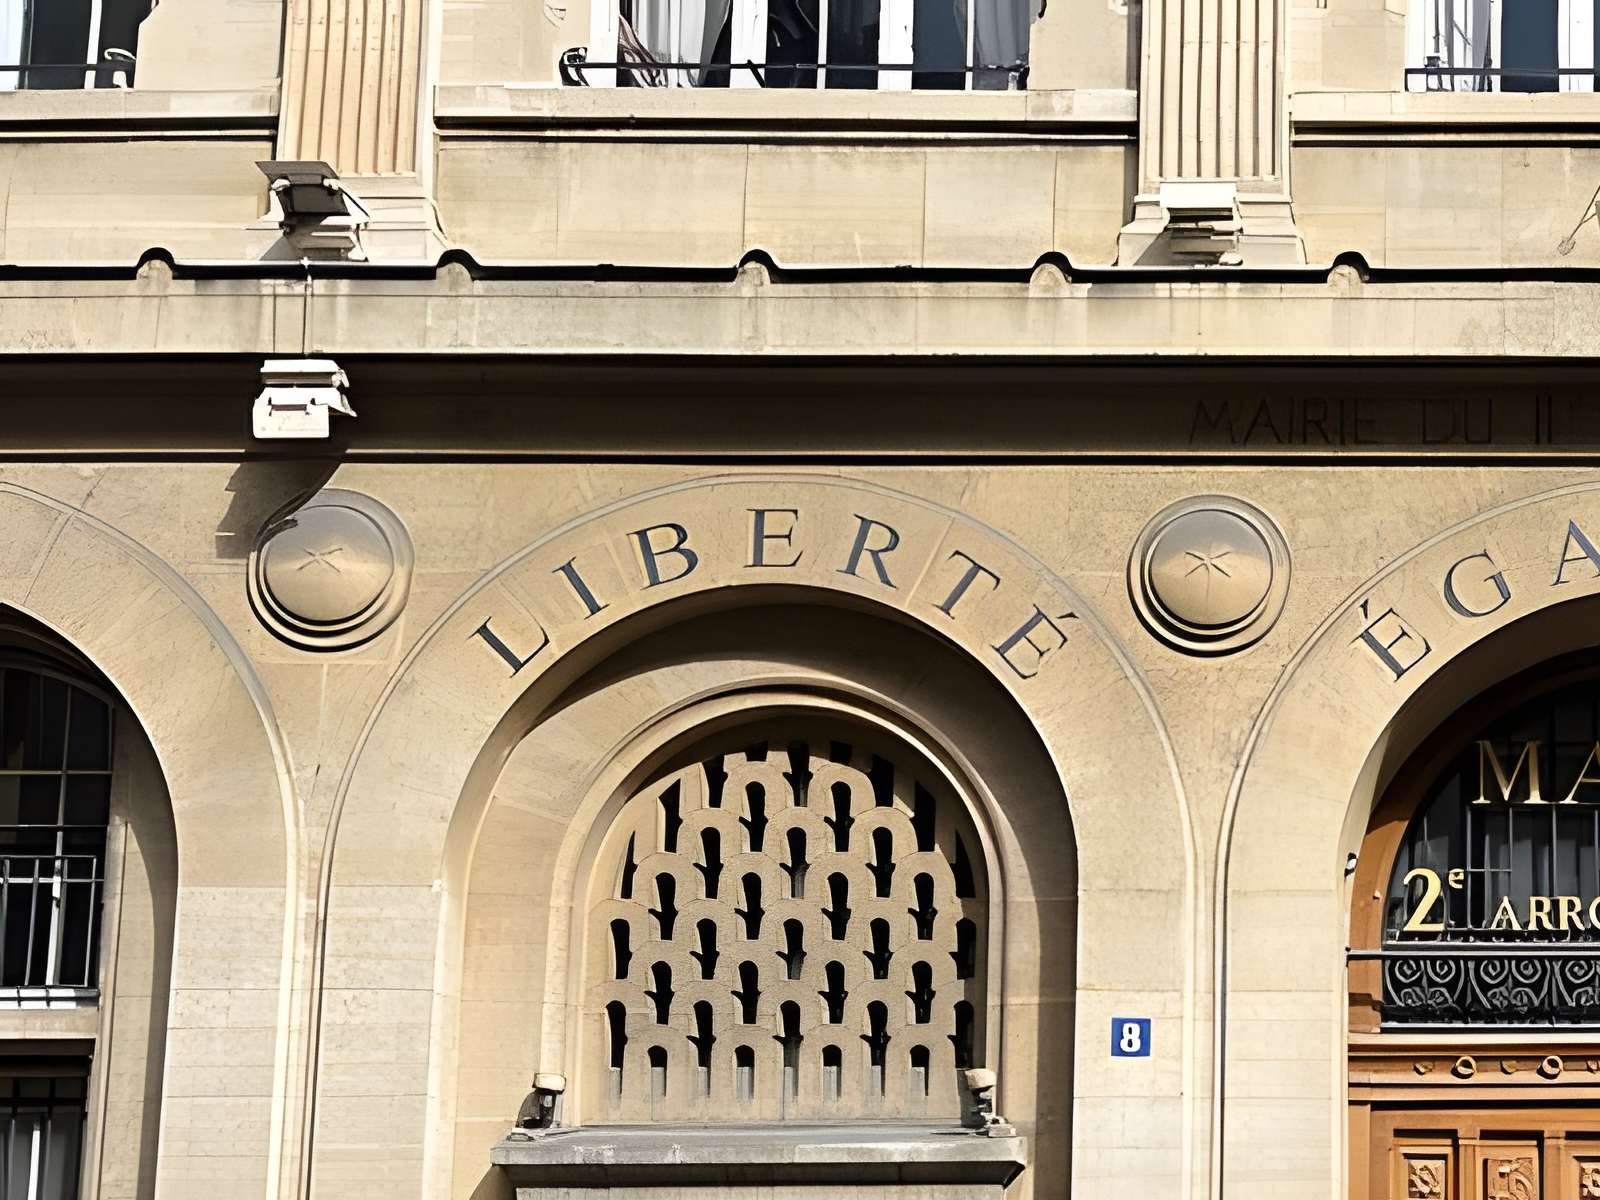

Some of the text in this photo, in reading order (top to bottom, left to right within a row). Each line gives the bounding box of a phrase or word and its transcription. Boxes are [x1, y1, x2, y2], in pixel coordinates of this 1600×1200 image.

[1189, 398, 1379, 445] MAIRIE
[1421, 398, 1492, 445] DU
[467, 508, 1079, 680] LIBERTÉ
[1120, 1022, 1141, 1053] 8
